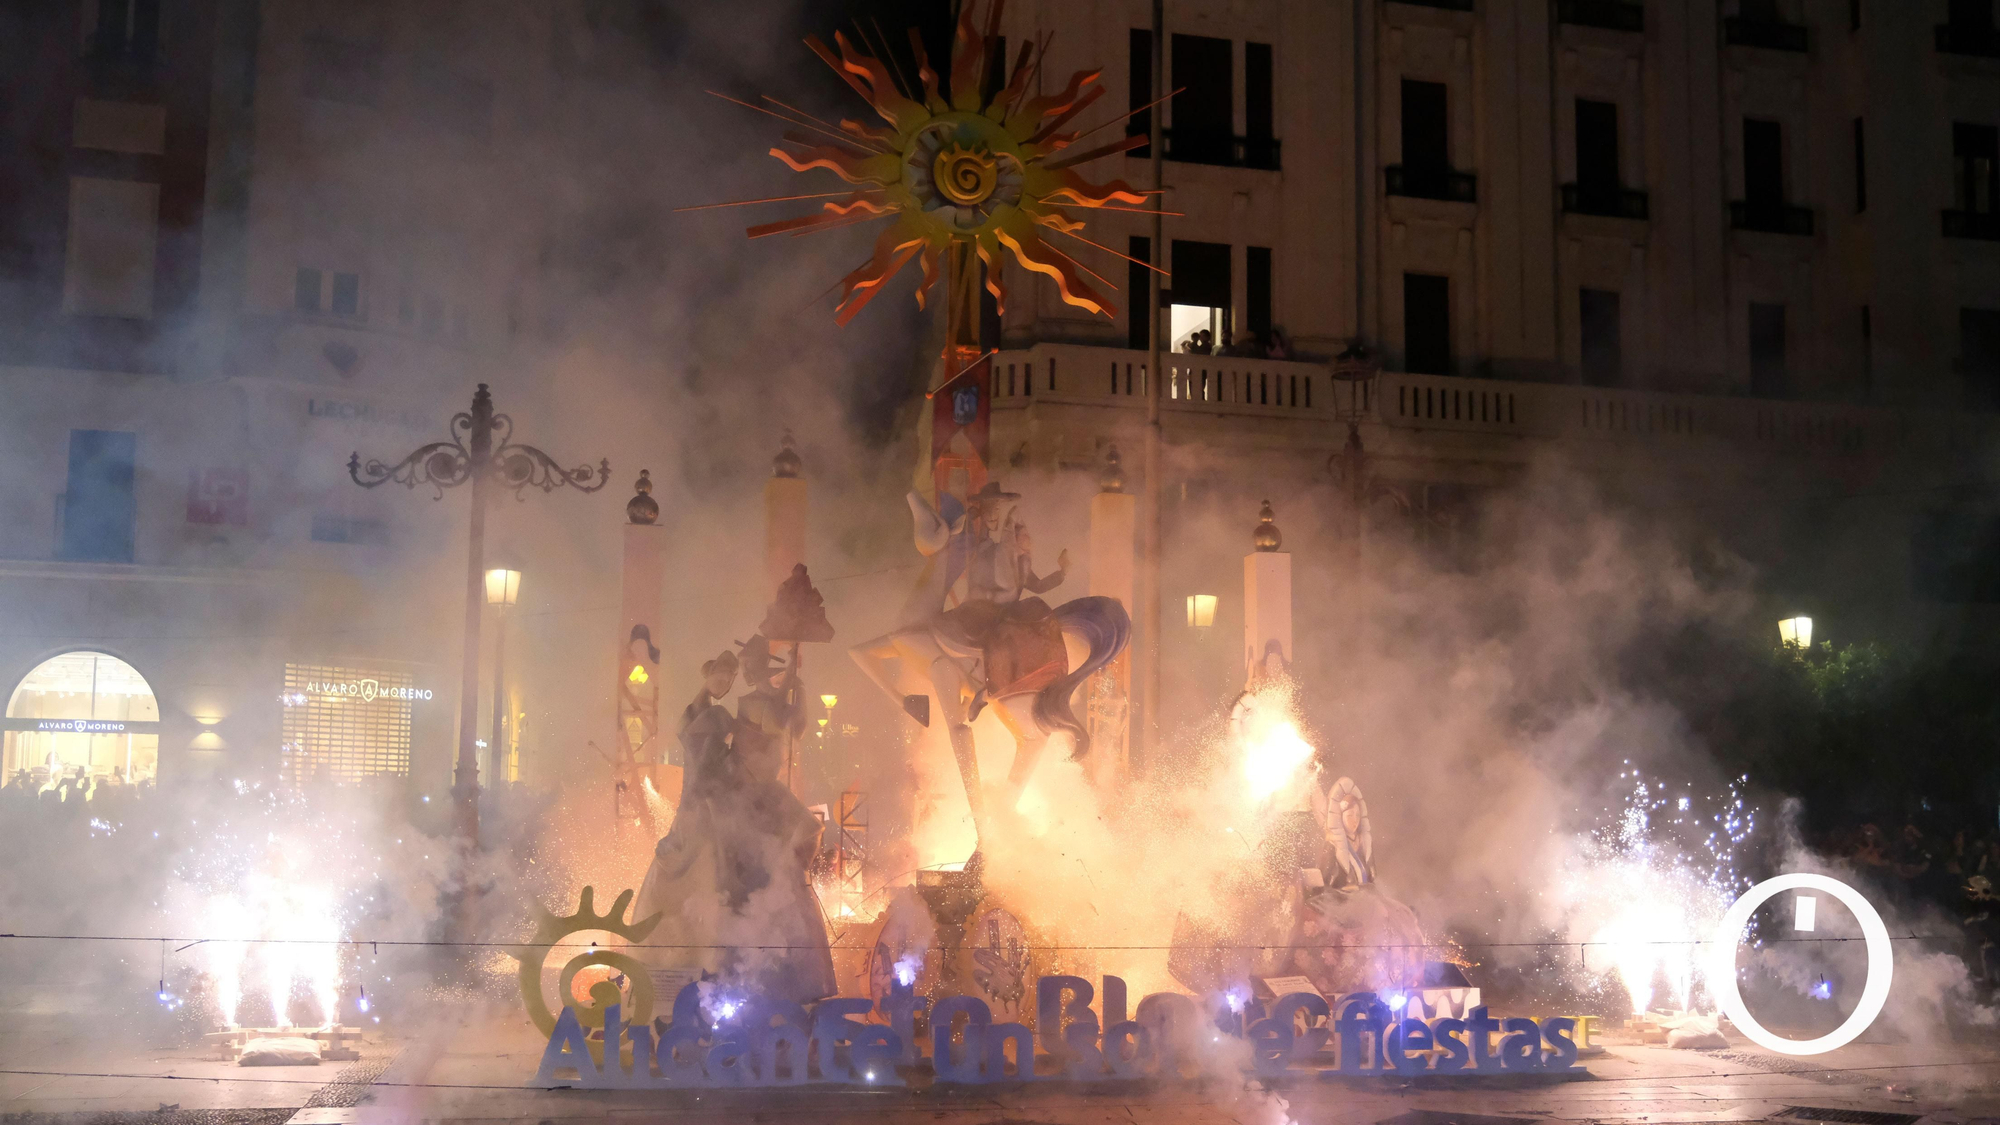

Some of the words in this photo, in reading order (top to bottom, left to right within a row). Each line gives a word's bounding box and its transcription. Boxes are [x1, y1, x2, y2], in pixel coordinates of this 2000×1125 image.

[306, 682, 358, 695] ALVARO
[379, 687, 433, 700] MORENO
[87, 723, 125, 731] MORENO
[533, 1003, 906, 1083] Alicante
[1334, 997, 1578, 1072] fiestas
